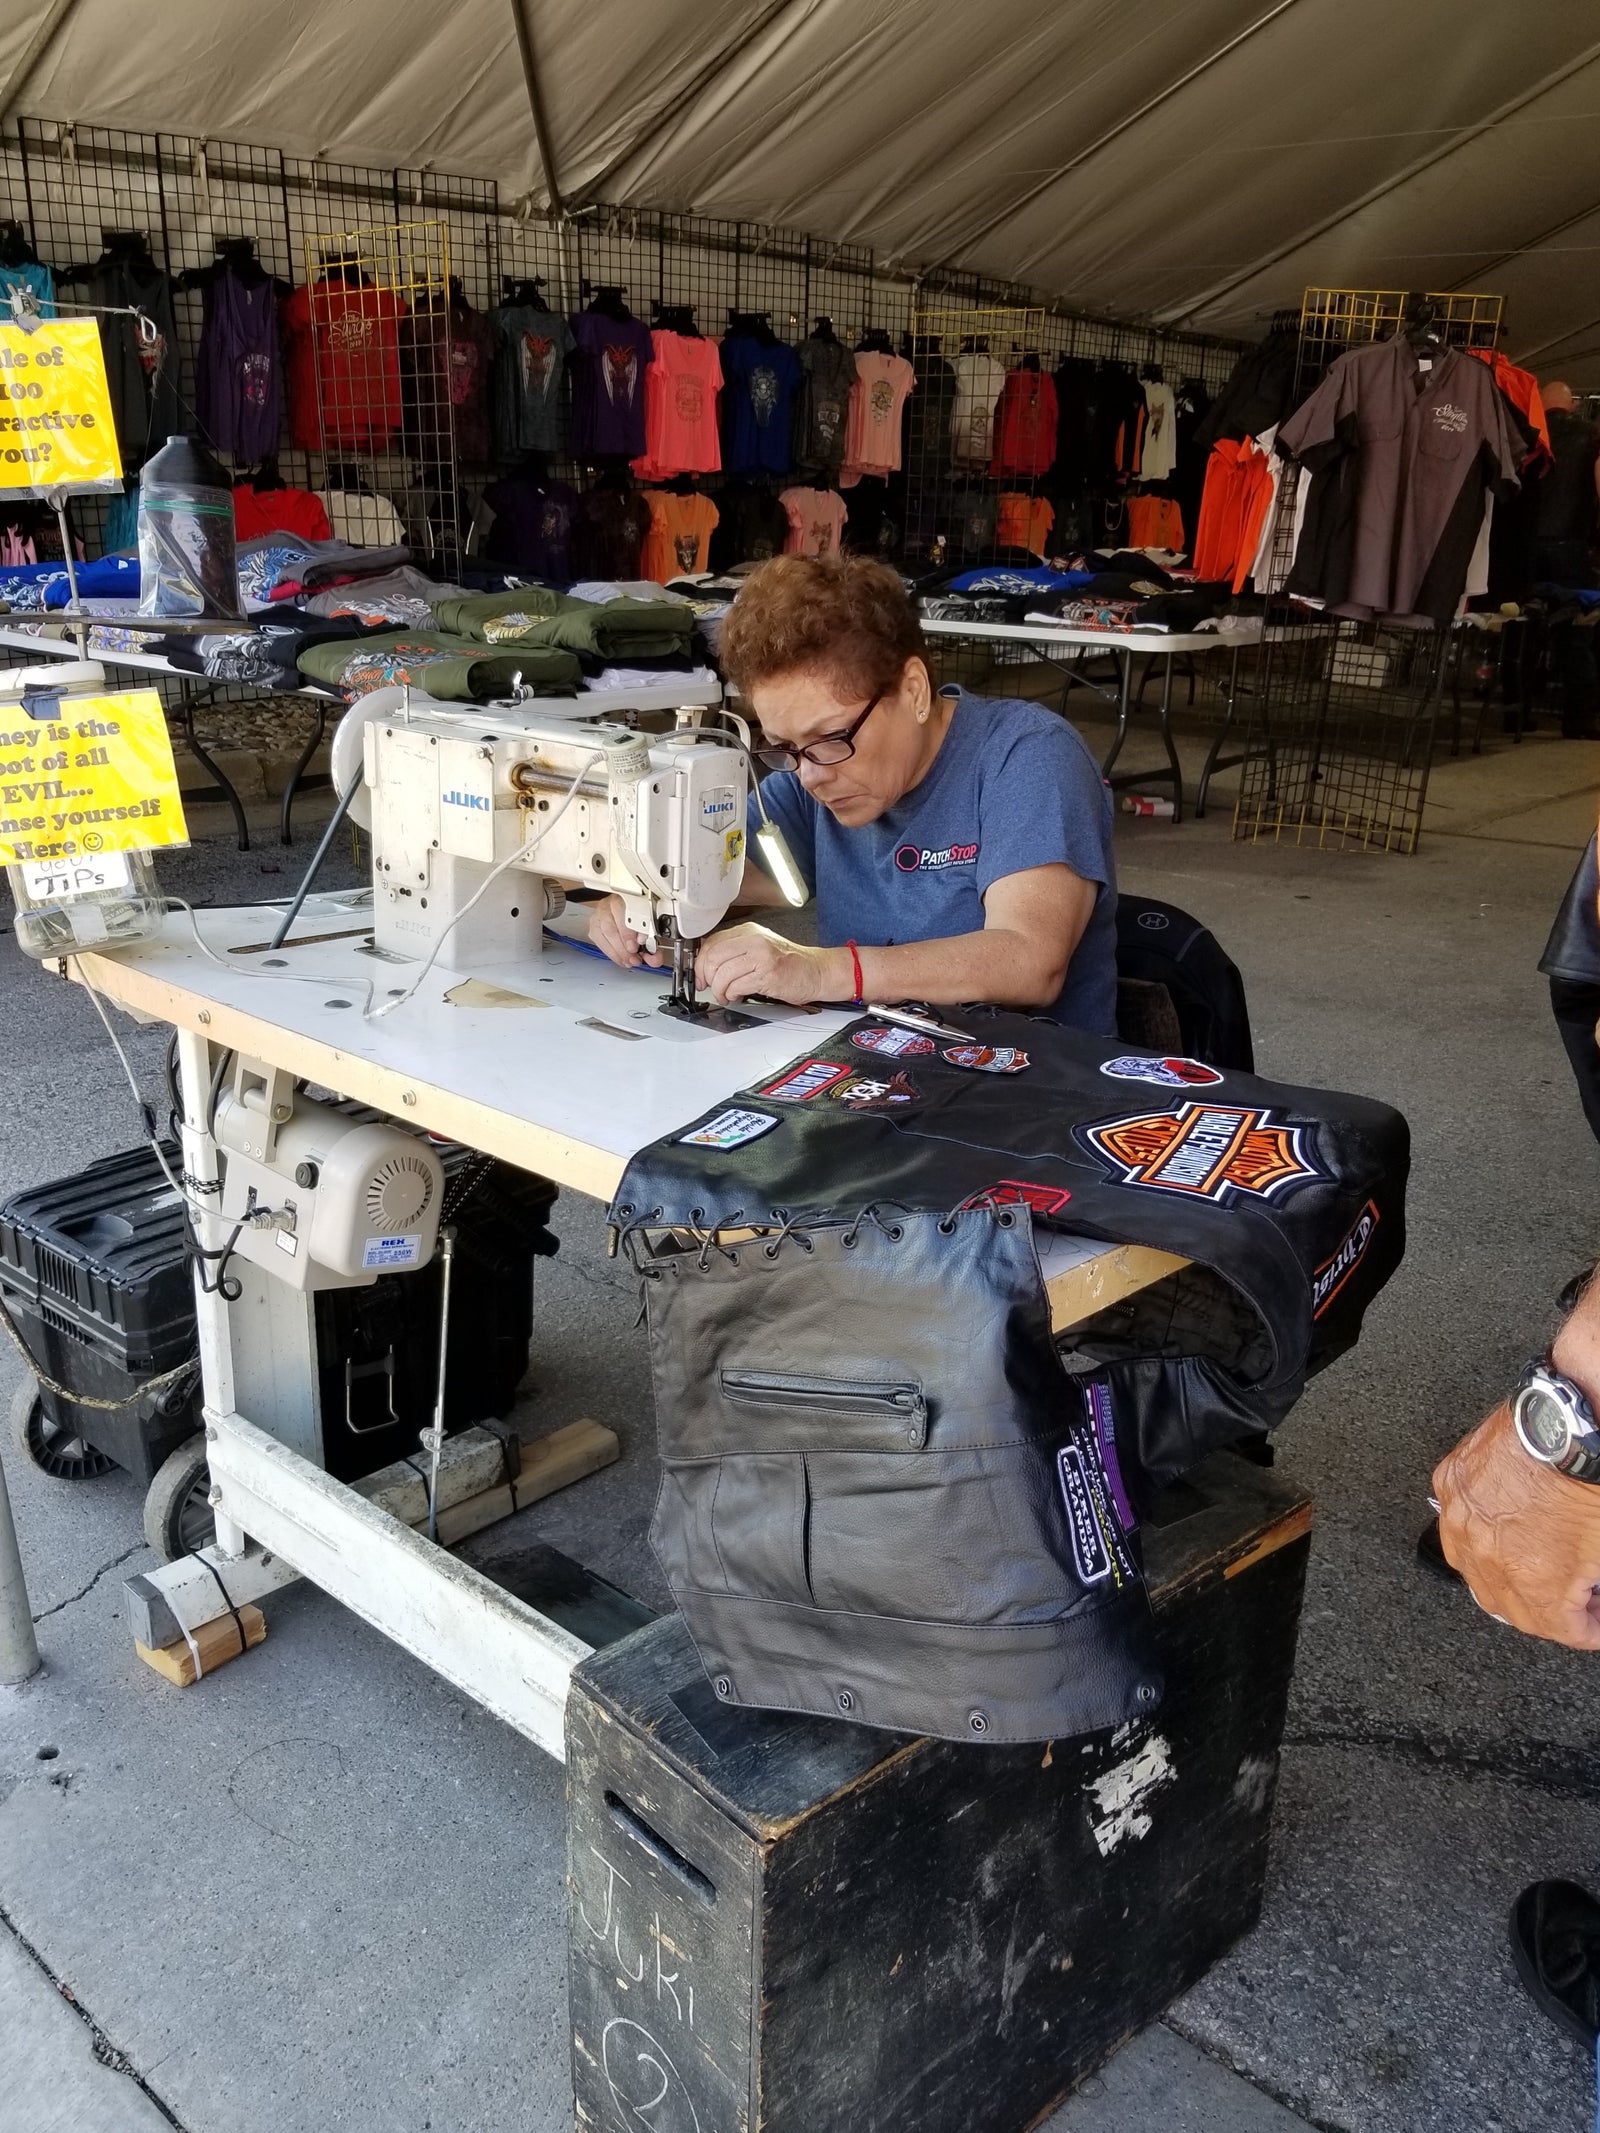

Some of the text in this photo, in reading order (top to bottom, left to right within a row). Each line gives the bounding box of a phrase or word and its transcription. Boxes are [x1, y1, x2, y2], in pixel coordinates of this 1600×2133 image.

[36, 346, 64, 367] of
[0, 443, 52, 463] ou?
[47, 723, 70, 741] is
[75, 719, 120, 738] the
[42, 751, 69, 770] of
[75, 747, 109, 767] all
[1, 780, 94, 804] EVIL...
[443, 790, 490, 811] JUKI
[0, 798, 161, 833] nse yourself
[704, 802, 733, 814] JUKI
[12, 841, 76, 860] Here
[1154, 1111, 1236, 1187] HARLEY-DAVIDSON
[381, 1238, 405, 1246] REX
[1063, 1456, 1094, 1575] GRANDPA
[1074, 1470, 1098, 1555] BIKER
[1116, 1546, 1135, 1578] NOT
